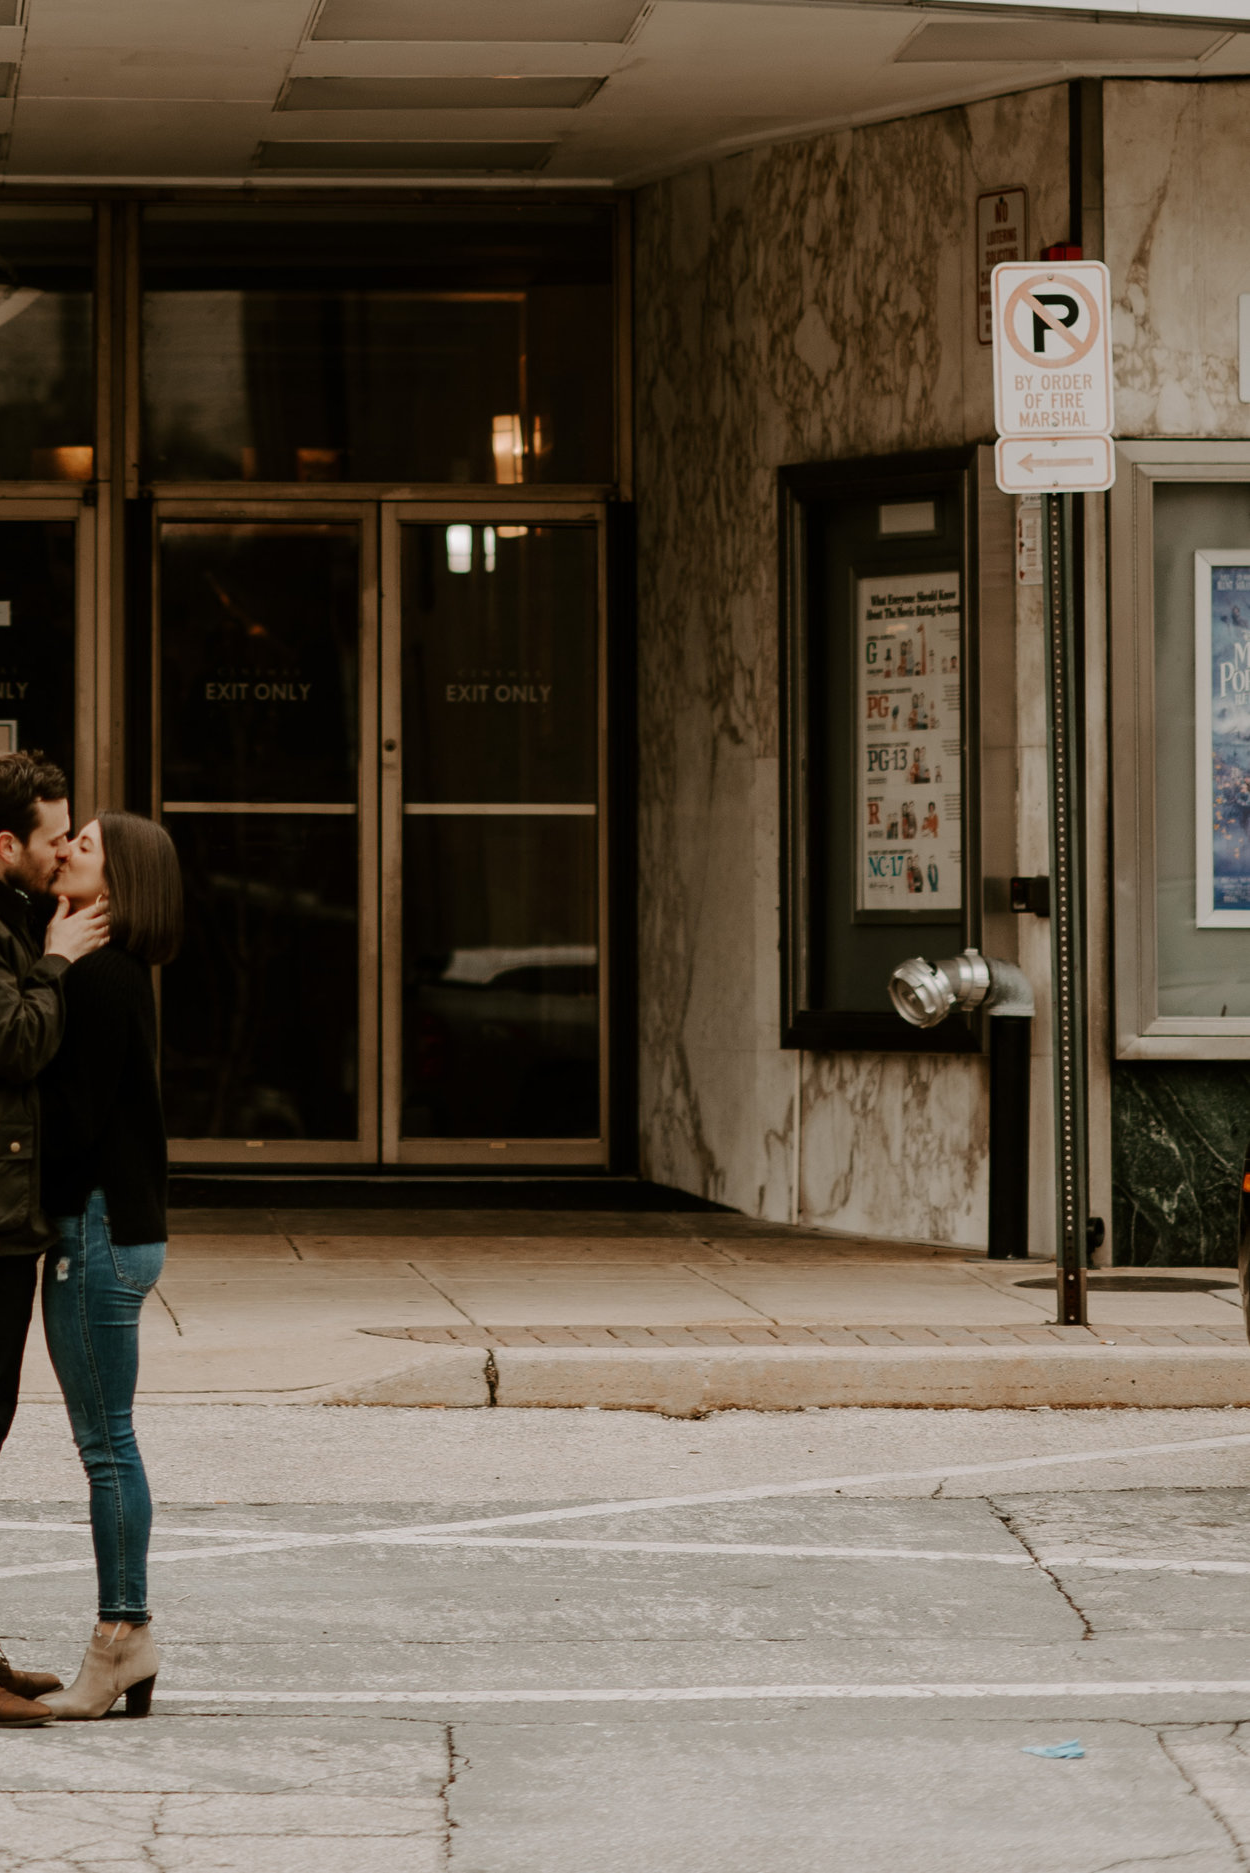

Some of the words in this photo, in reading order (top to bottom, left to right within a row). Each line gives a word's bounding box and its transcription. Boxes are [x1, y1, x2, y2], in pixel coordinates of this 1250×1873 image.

[1014, 375, 1034, 391] BY
[1041, 373, 1093, 391] ORDER
[1024, 393, 1045, 409] OF
[1051, 392, 1085, 409] FIRE
[1018, 410, 1091, 428] MARSHAL
[866, 642, 877, 664] G
[205, 683, 250, 701] EXIT
[253, 683, 312, 701] ONLY
[446, 684, 490, 703] EXIT
[494, 685, 552, 703] ONLY
[867, 696, 889, 718] PG
[868, 803, 880, 824] R
